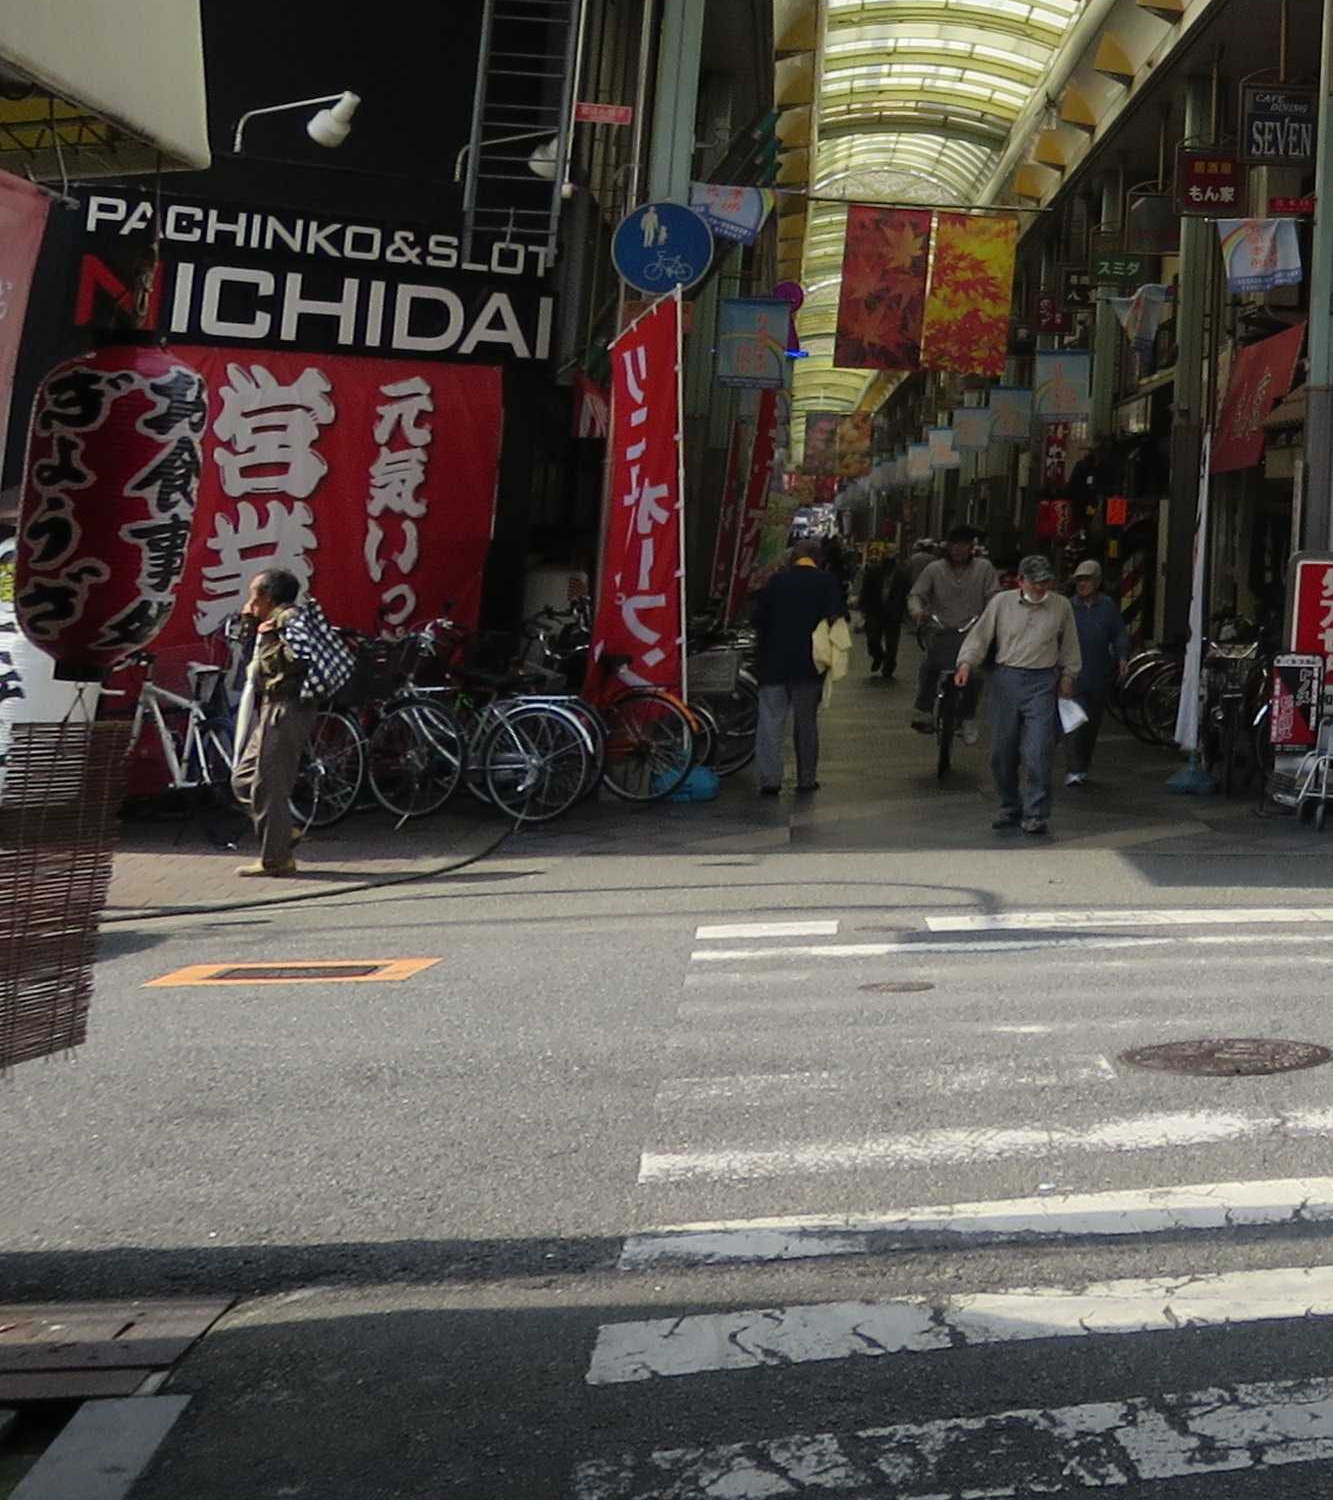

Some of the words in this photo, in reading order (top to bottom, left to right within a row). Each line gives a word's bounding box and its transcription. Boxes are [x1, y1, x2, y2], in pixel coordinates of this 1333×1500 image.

[1251, 117, 1313, 157] SEVEN
[1187, 184, 1236, 204] もん家
[86, 195, 559, 278] PACHINKO&SLOT
[1097, 260, 1141, 277] スミダ
[18, 368, 137, 638] ぎょうざ
